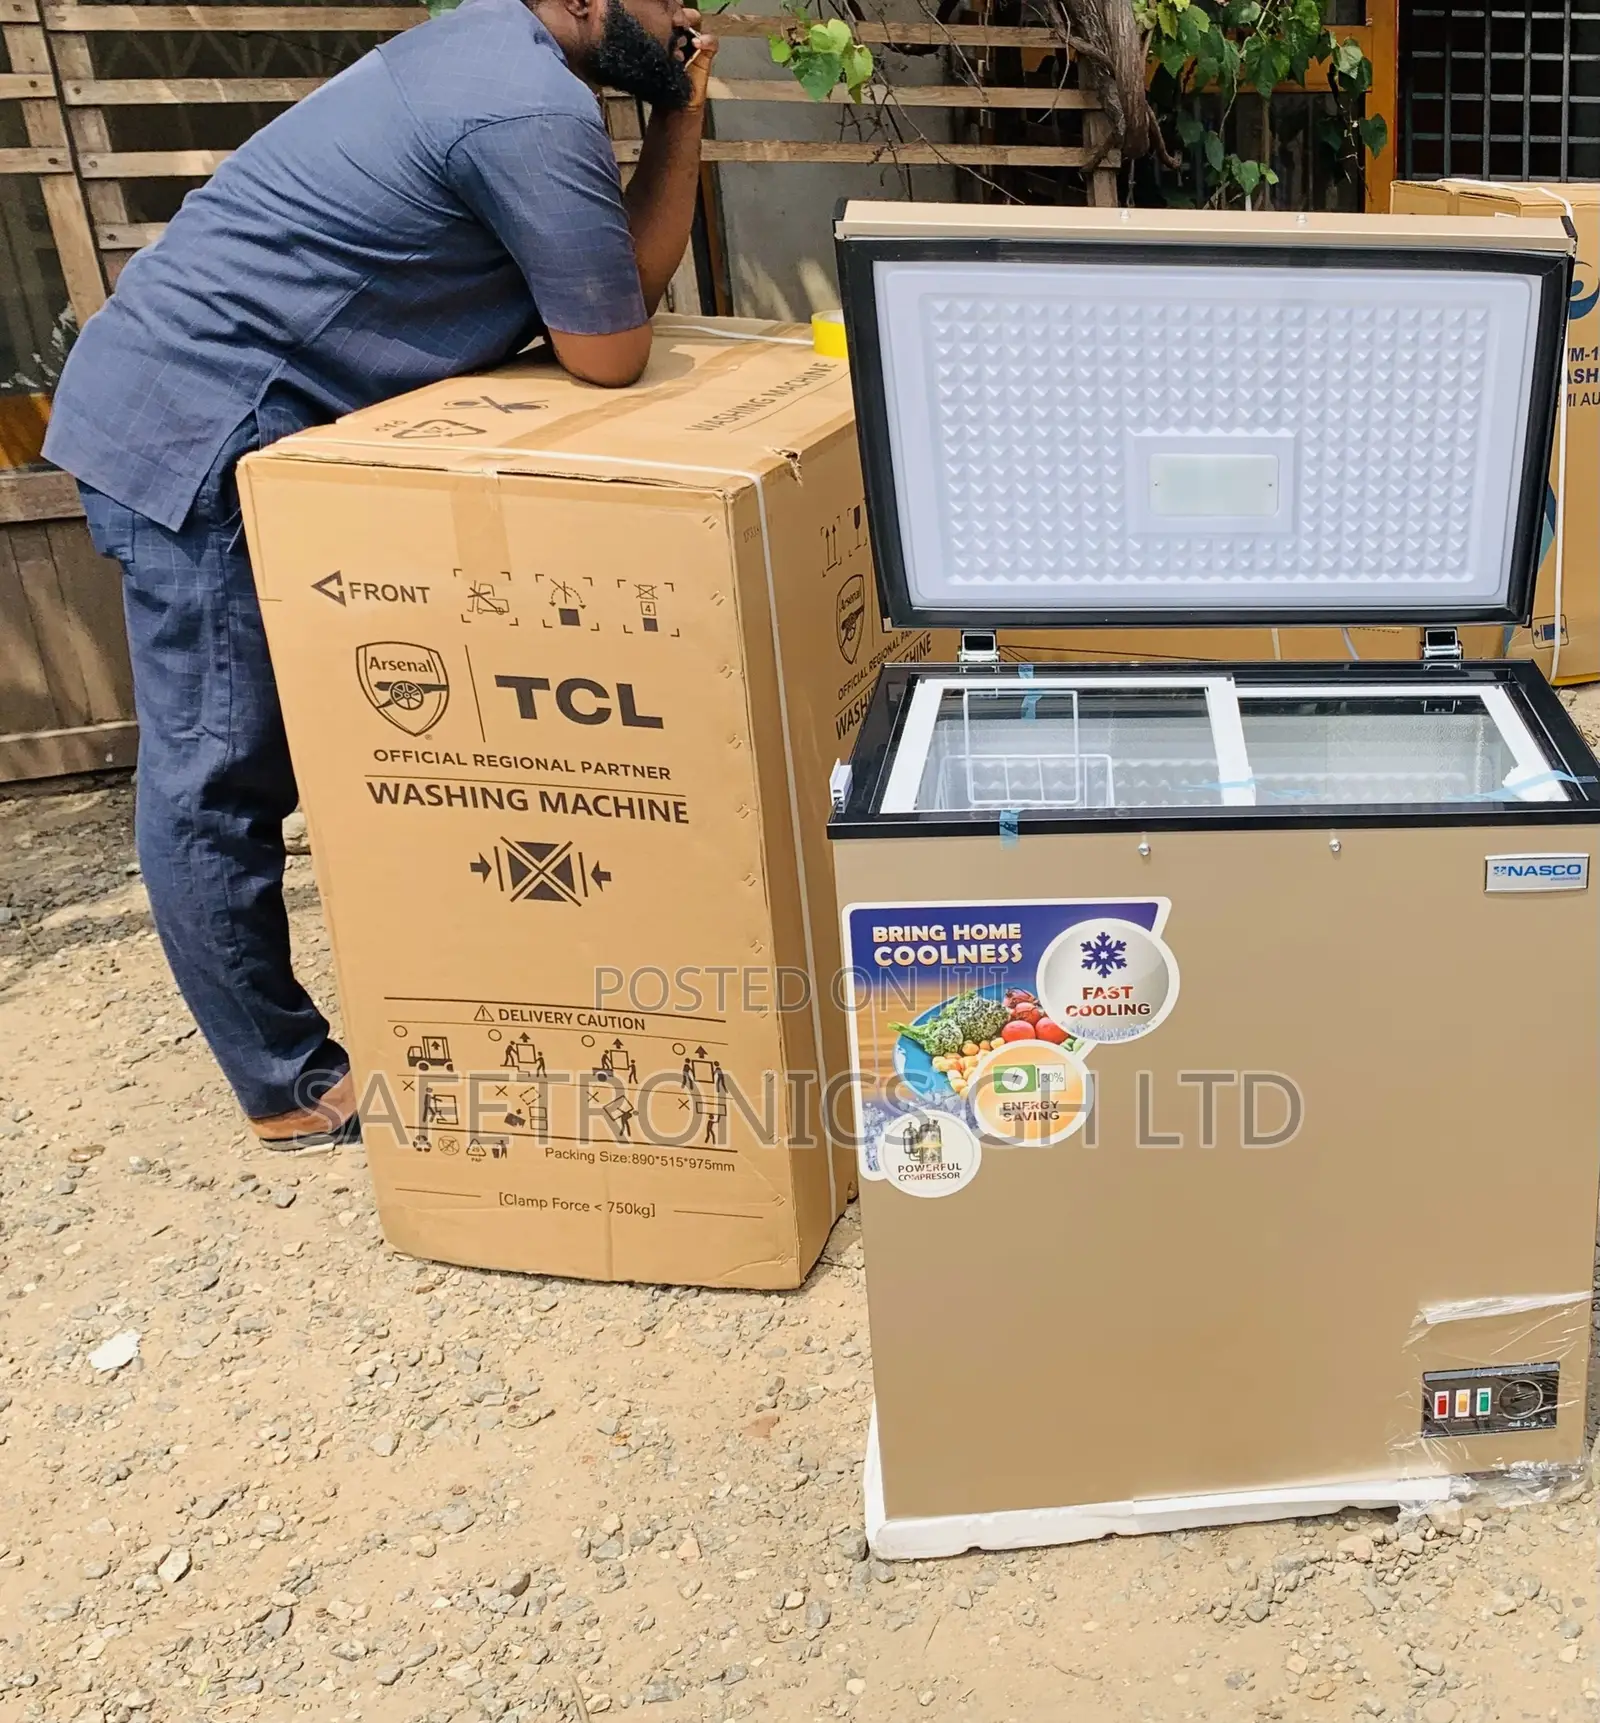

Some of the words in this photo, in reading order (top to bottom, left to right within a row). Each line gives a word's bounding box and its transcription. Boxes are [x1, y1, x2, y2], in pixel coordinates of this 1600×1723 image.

[1567, 346, 1599, 362] M-1
[684, 397, 777, 432] WASHING
[761, 361, 839, 398] MACHINE
[349, 581, 431, 606] FRONT
[368, 654, 434, 676] Arsenal
[837, 667, 869, 701] OFFICIAL
[868, 638, 903, 673] REGIONAL
[494, 674, 665, 730] TCL
[373, 748, 468, 766] OFFICIAL
[472, 754, 576, 773] REGIONAL
[581, 762, 671, 781] PARTNER
[365, 781, 530, 812] WASHING
[540, 791, 690, 825] MACHINE
[1507, 864, 1582, 877] NASCO
[872, 925, 947, 943] BRING
[953, 923, 1022, 941] HOME
[874, 943, 1023, 967] COOLNESS
[1082, 985, 1134, 1000] FAST
[499, 1008, 573, 1026] DELIVERY
[576, 1013, 646, 1031] CAUTION
[1065, 1003, 1151, 1017] COOLING
[1041, 1072, 1064, 1083] 30%
[1002, 1100, 1060, 1112] ENERGY
[1002, 1110, 1060, 1122] SAVING
[545, 1147, 595, 1164] Packing
[898, 1162, 962, 1174] POWERFUL
[898, 1171, 961, 1182] COMPRESSOR
[499, 1191, 548, 1208] [Clamp
[551, 1195, 590, 1212] Force
[606, 1199, 656, 1217] 750kg]
